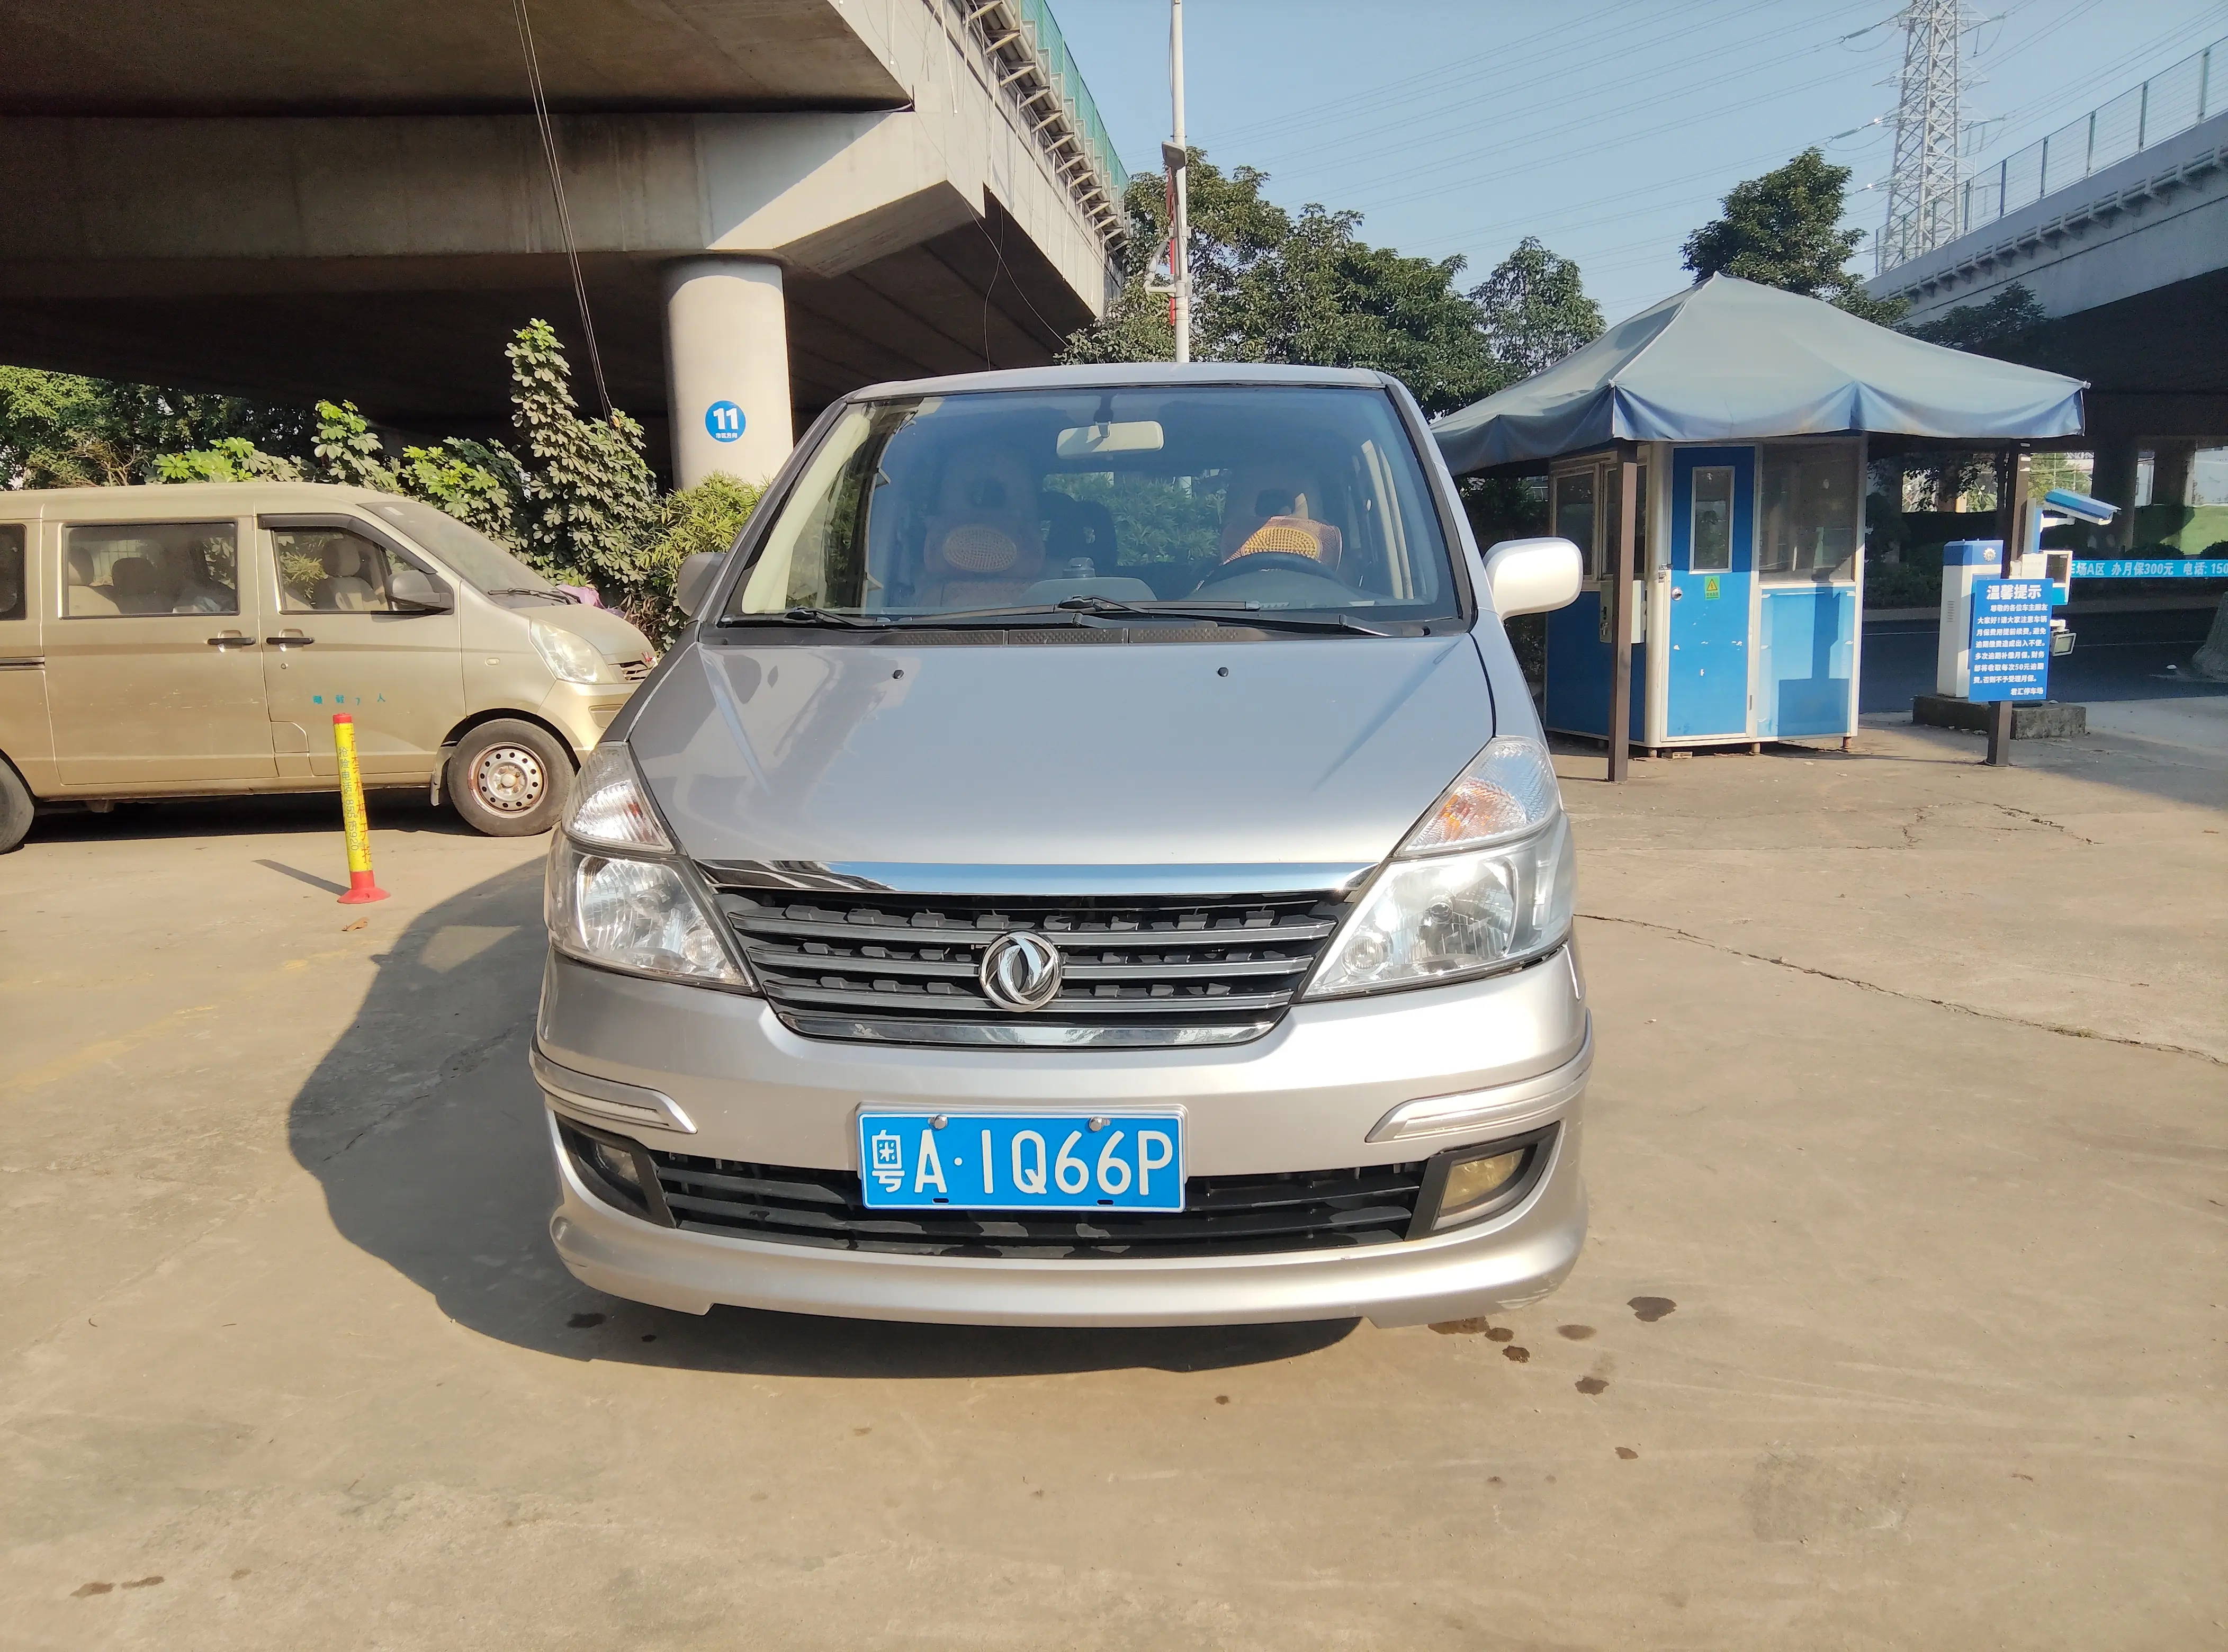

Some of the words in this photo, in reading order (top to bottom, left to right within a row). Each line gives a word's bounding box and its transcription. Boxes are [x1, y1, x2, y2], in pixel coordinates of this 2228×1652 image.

[713, 408, 739, 429] 11
[2111, 562, 2174, 576] 办月保300元
[1987, 584, 2042, 600] 温馨提示
[872, 1129, 1173, 1196] 粤A·1Q66P
